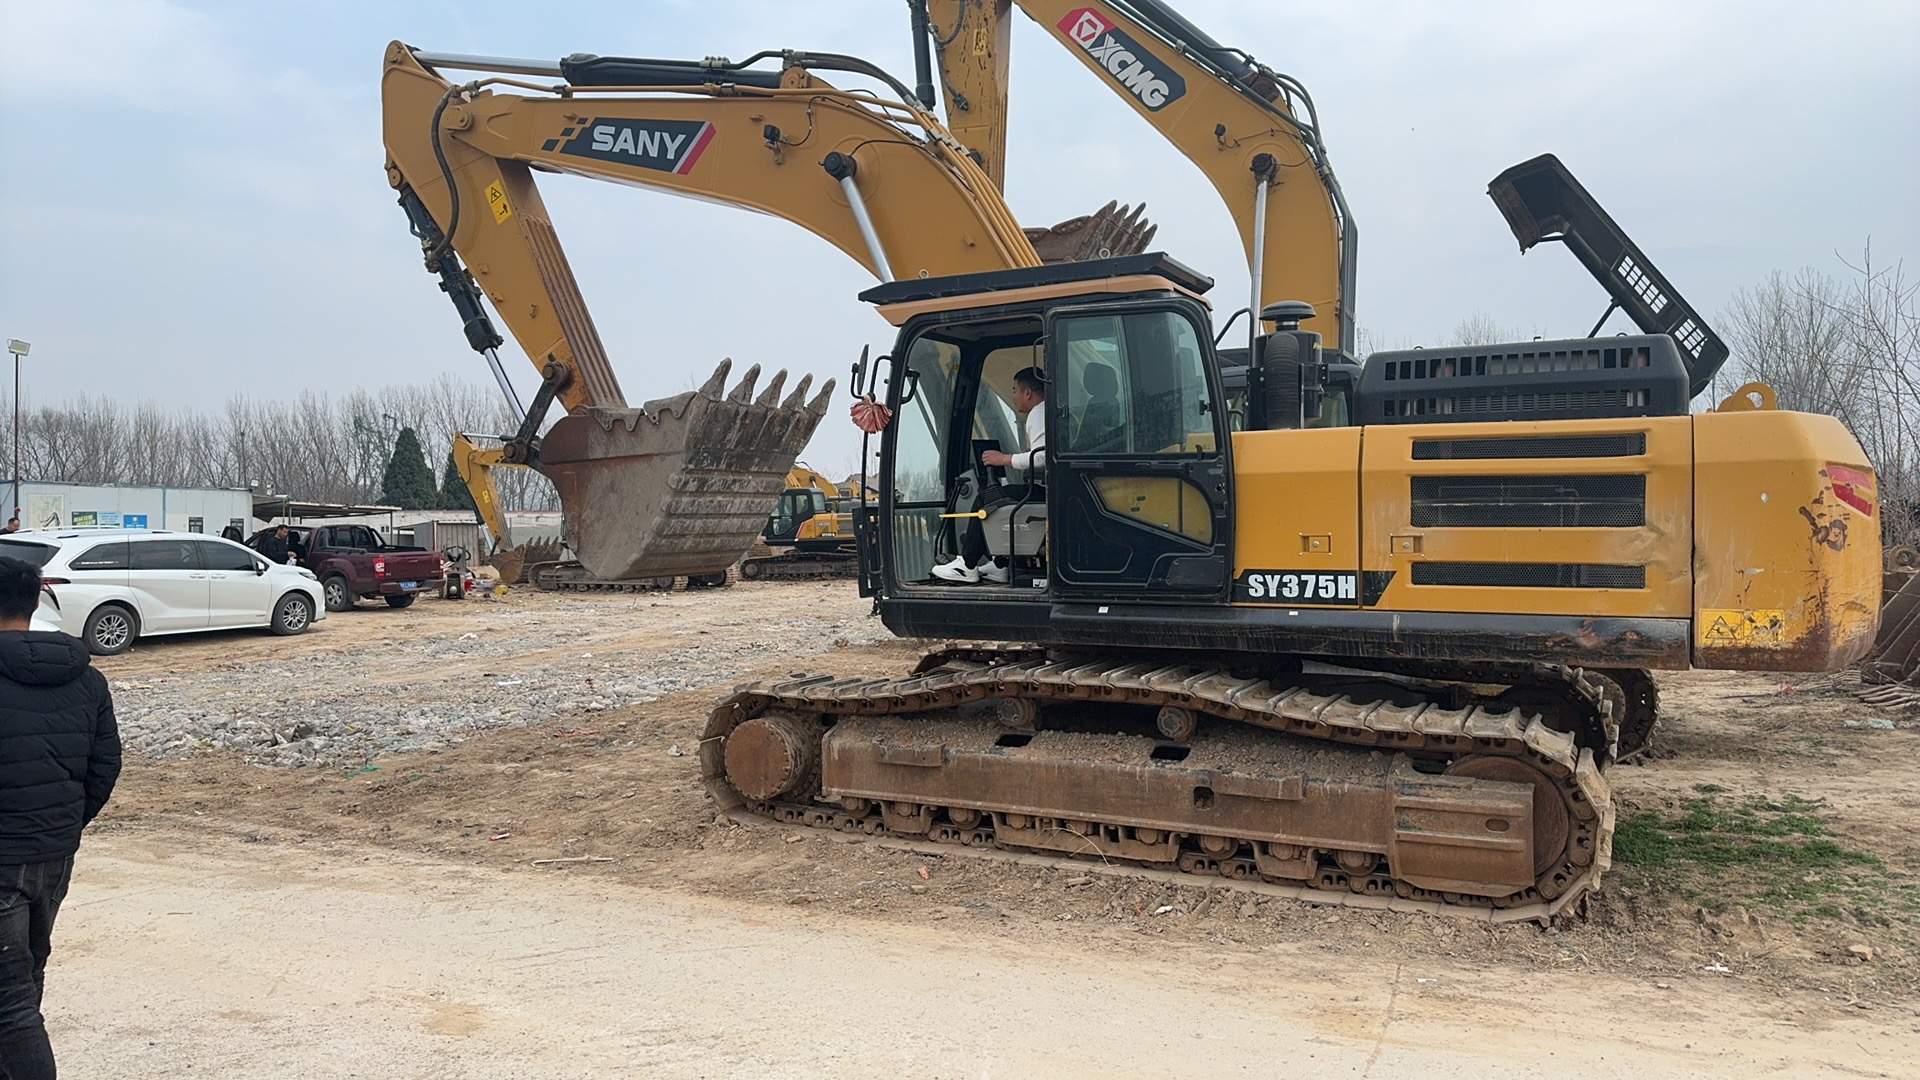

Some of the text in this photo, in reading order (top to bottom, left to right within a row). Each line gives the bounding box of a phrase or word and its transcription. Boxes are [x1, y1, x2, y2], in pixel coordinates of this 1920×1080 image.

[1088, 33, 1169, 107] XCMG
[592, 125, 687, 160] SANY
[1248, 574, 1356, 599] SY375H
